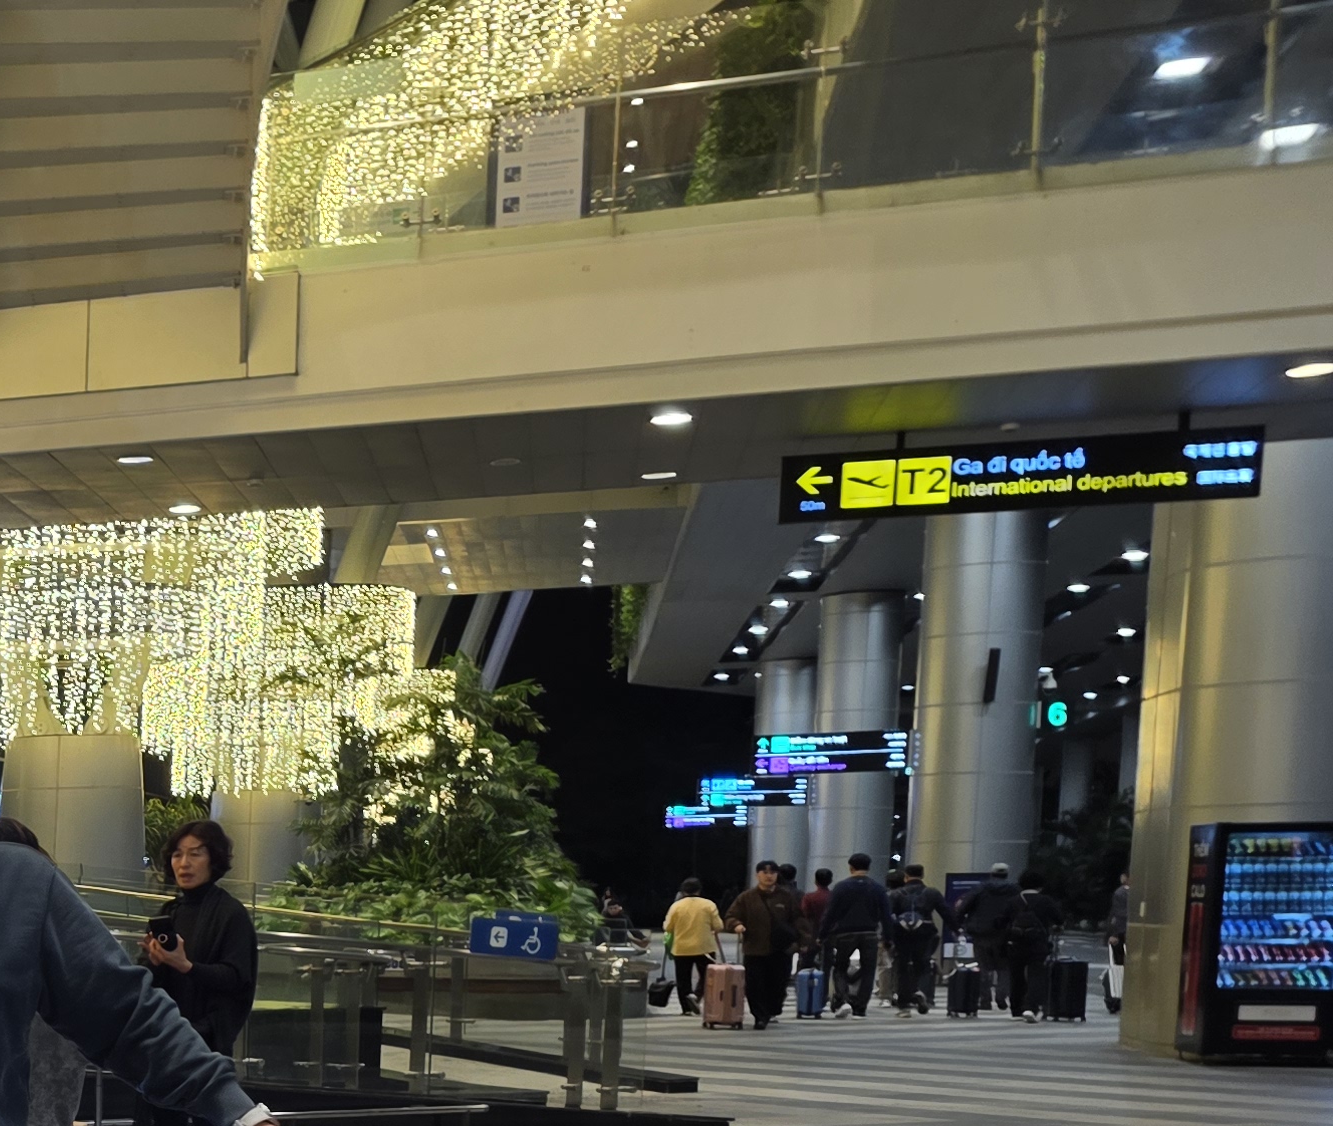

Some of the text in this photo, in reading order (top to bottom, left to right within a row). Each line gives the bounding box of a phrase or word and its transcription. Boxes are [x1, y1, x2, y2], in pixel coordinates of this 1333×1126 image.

[953, 457, 983, 475] Ga
[901, 467, 948, 495] T2
[952, 474, 1073, 498] International
[1076, 470, 1189, 493] departures
[1047, 701, 1068, 727] 6
